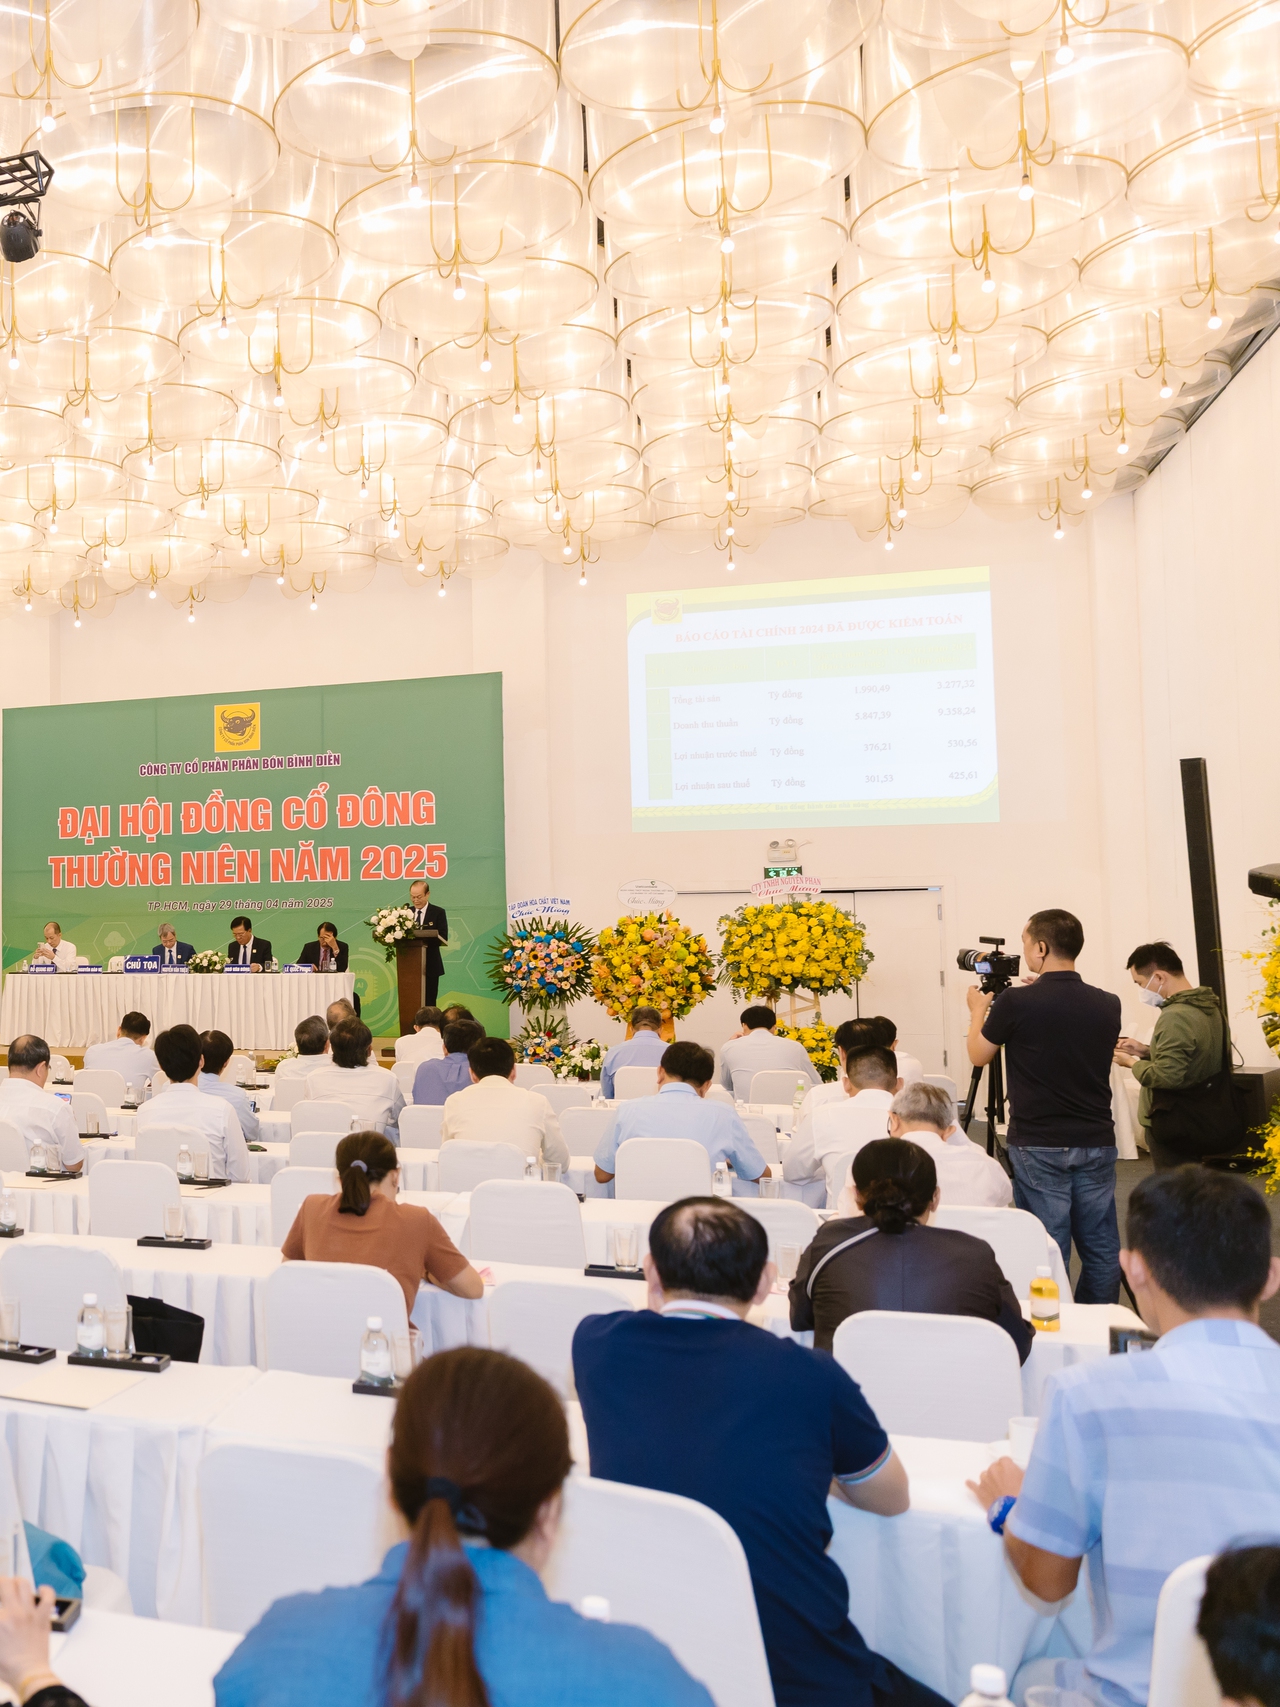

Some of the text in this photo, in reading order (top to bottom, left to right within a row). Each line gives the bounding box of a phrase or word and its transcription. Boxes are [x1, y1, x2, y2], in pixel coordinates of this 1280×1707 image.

[800, 624, 824, 634] 2024
[855, 711, 892, 720] 5.847,39
[938, 707, 976, 716] 9.358,24
[864, 742, 892, 752] 376,21
[947, 739, 978, 748] 530,56
[140, 750, 341, 777] CÔNG TY CỔ PHẦN PHÂN BÓN BÌNH ĐIỀN
[865, 774, 894, 784] 301,53
[948, 771, 978, 780] 425,61
[58, 782, 436, 845] ĐẠI HỘI ĐỒNG CỔ ĐÔNG
[48, 840, 448, 888] THƯỜNG NIÊN NĂM 2025
[147, 900, 190, 912] TP.HCM,
[192, 900, 217, 912] ngày
[219, 900, 232, 910] 29
[234, 898, 264, 911] tháng
[266, 898, 279, 909] 04
[306, 897, 334, 909] 2025
[126, 958, 141, 970] CHỦ
[143, 961, 158, 970] TỌA
